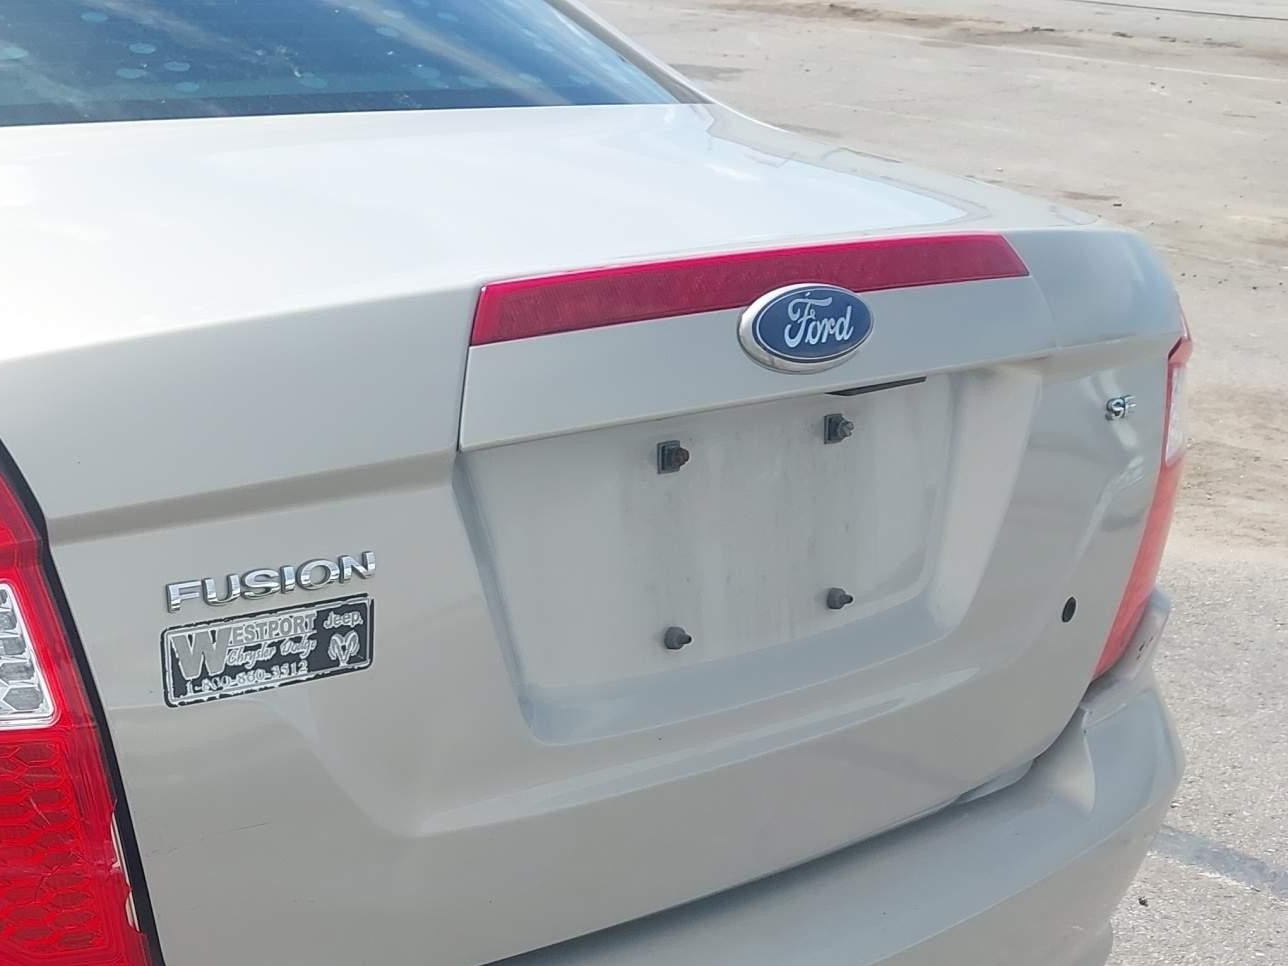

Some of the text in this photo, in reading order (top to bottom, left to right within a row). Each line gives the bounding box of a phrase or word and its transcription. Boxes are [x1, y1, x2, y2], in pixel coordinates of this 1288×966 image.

[784, 291, 854, 348] Ford
[166, 551, 376, 613] FUSION
[171, 611, 317, 680] WESTPORT
[323, 611, 362, 629] Jeep
[227, 633, 318, 669] Chrysler Dodge
